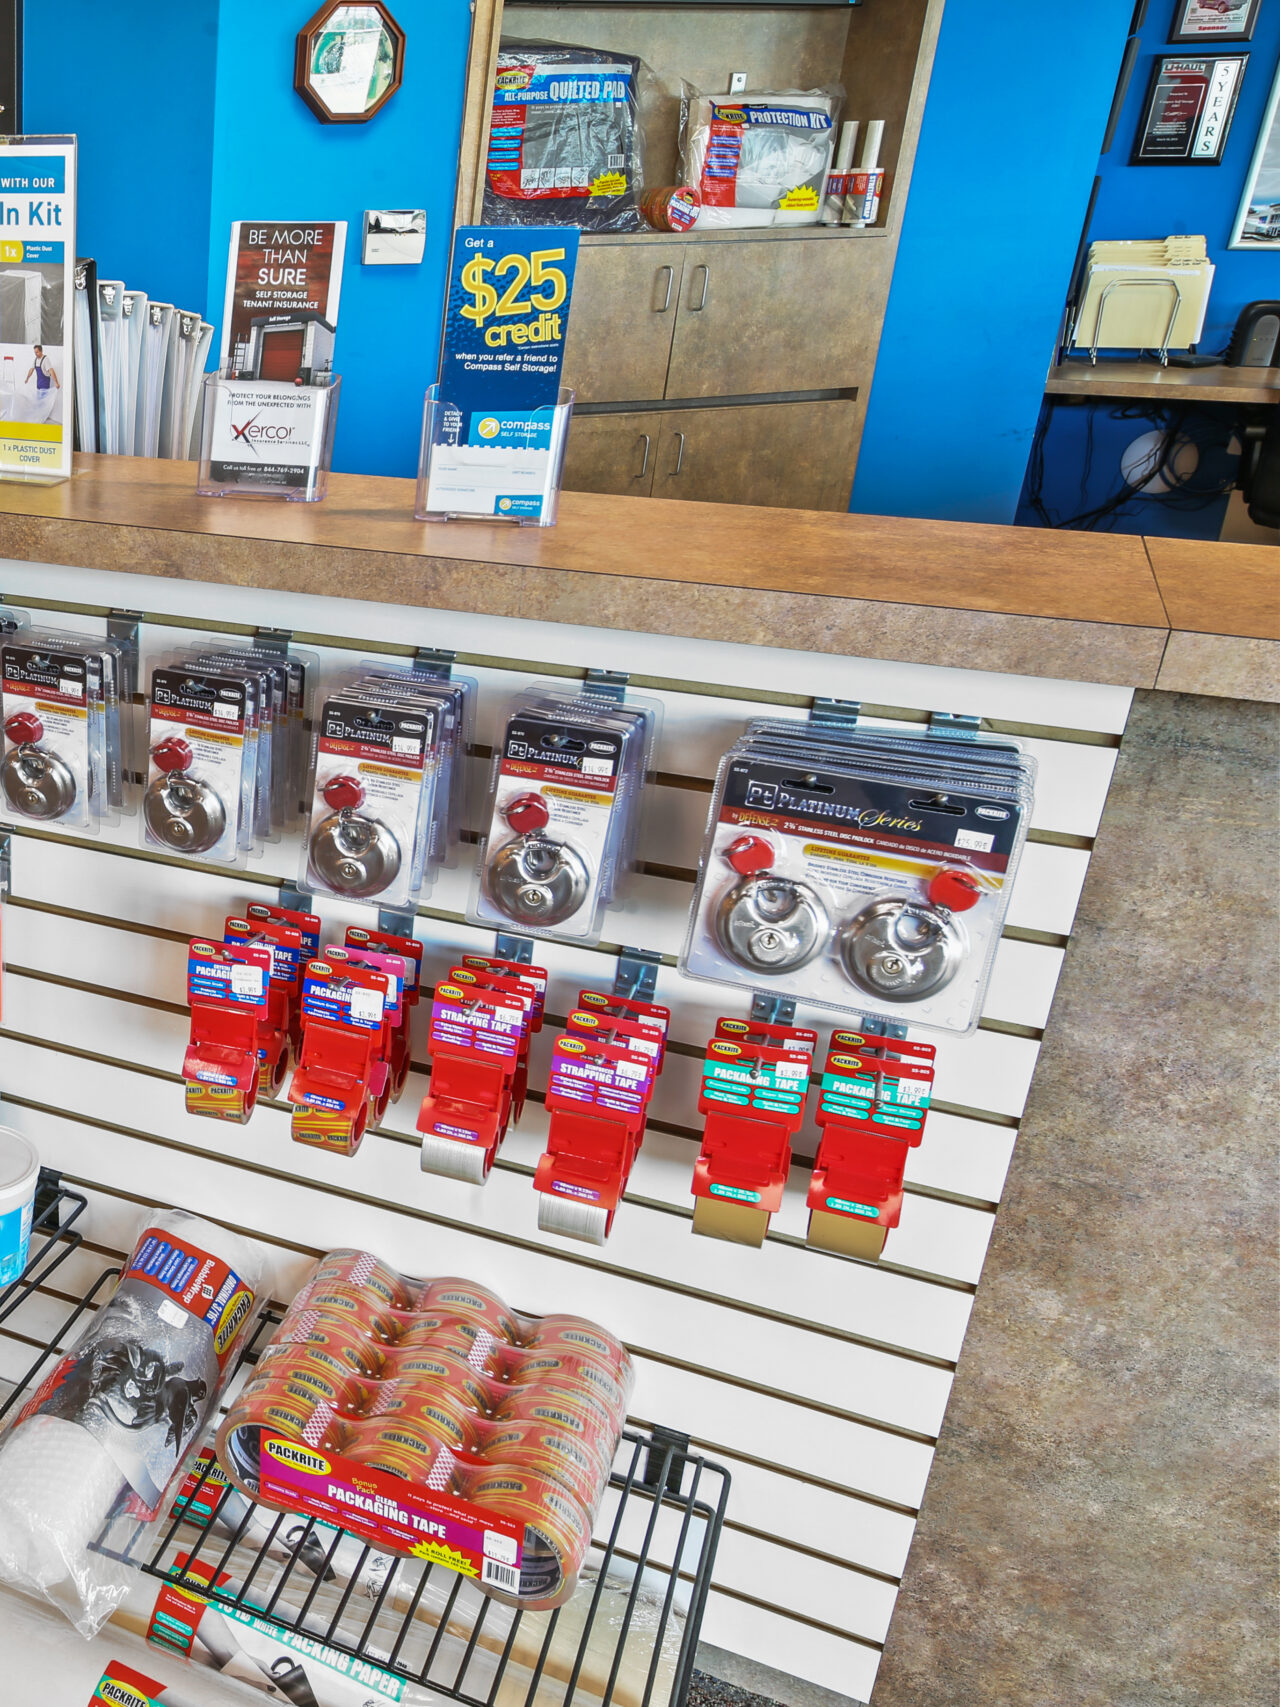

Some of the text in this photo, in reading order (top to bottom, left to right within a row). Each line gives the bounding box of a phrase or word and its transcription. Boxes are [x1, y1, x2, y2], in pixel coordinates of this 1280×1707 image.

[1164, 63, 1205, 71] U-HAUL
[504, 80, 626, 102] ALL-PURPOSE QUILTED PAD
[749, 111, 809, 128] PROTECTION
[809, 113, 828, 129] KIT
[0, 177, 29, 188] WITH
[32, 177, 55, 188] OUR
[28, 201, 62, 226] Kit
[248, 229, 324, 245] BE MORE
[464, 237, 494, 248] Get a
[4, 245, 17, 257] 1x
[262, 248, 308, 265] THAN
[257, 268, 307, 286] SURE
[255, 290, 308, 299] SELF STORAGE
[459, 247, 568, 328] $25
[242, 300, 319, 309] TENANT INSURANCE
[484, 312, 562, 348] credit
[455, 352, 558, 363] when you refer friend to
[463, 362, 557, 374] Compass Self Storage!
[257, 401, 295, 409] UNEXPECTED
[272, 394, 311, 402] BELONGINGS
[500, 420, 551, 432] compass
[12, 444, 57, 456] PLASTIC DUST
[19, 454, 41, 464] COVER
[263, 466, 305, 475] 844-769-2904
[511, 499, 540, 507] compass
[19, 669, 58, 685] PLATINUM
[171, 694, 213, 711] PLATINUM
[344, 726, 391, 744] PLATINUM
[589, 743, 615, 752] PACKRITE
[527, 747, 578, 765] PLATINUM
[776, 792, 862, 821] PLATINUM
[858, 808, 922, 832] Series
[797, 825, 876, 844] STAINLESS STEEL PADLOCK
[274, 951, 293, 962] TAPE
[438, 986, 462, 998] PACKRITE
[440, 1009, 512, 1034] STRAPPING TAPE
[722, 1022, 748, 1033] PACKRITE
[559, 1040, 584, 1052] PACKRITE
[831, 1056, 861, 1068] PACKRITE
[560, 1063, 638, 1090] STRAPPING TAPE
[209, 1086, 234, 1095] PACKRITE
[775, 1077, 799, 1091] TAPE
[896, 1093, 921, 1107] TAPE
[183, 1258, 217, 1306] BubbleWrap
[218, 1273, 238, 1307] ORIGINAL
[216, 1294, 253, 1349] PACKRITE
[268, 1442, 326, 1472] PACKRITE
[351, 1477, 378, 1489] Bonus
[355, 1484, 376, 1496] Pack
[375, 1494, 398, 1508] CLEAR
[412, 1494, 426, 1503] pays
[327, 1484, 447, 1540] PACKAGING TAPE
[429, 1548, 467, 1567] ROLL FREE!
[252, 1618, 401, 1698] WHITE PACKING PAPER
[102, 1682, 146, 1707] PACKRITE
